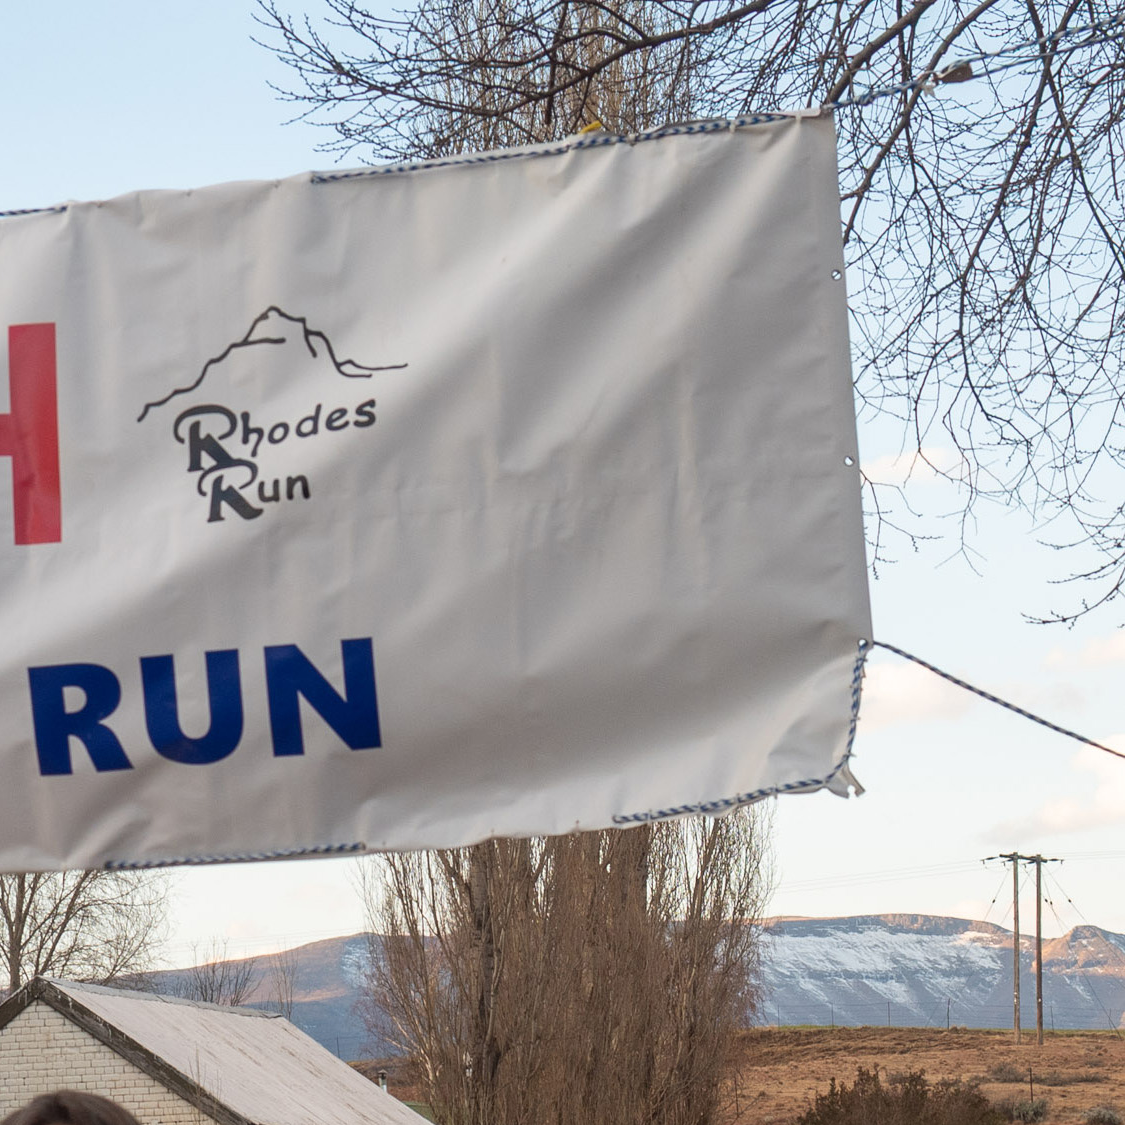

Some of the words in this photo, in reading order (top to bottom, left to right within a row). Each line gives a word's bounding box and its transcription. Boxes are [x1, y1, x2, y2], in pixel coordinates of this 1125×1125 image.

[174, 398, 377, 473] Rhodes
[197, 457, 311, 523] Run
[27, 636, 383, 777] RUN
